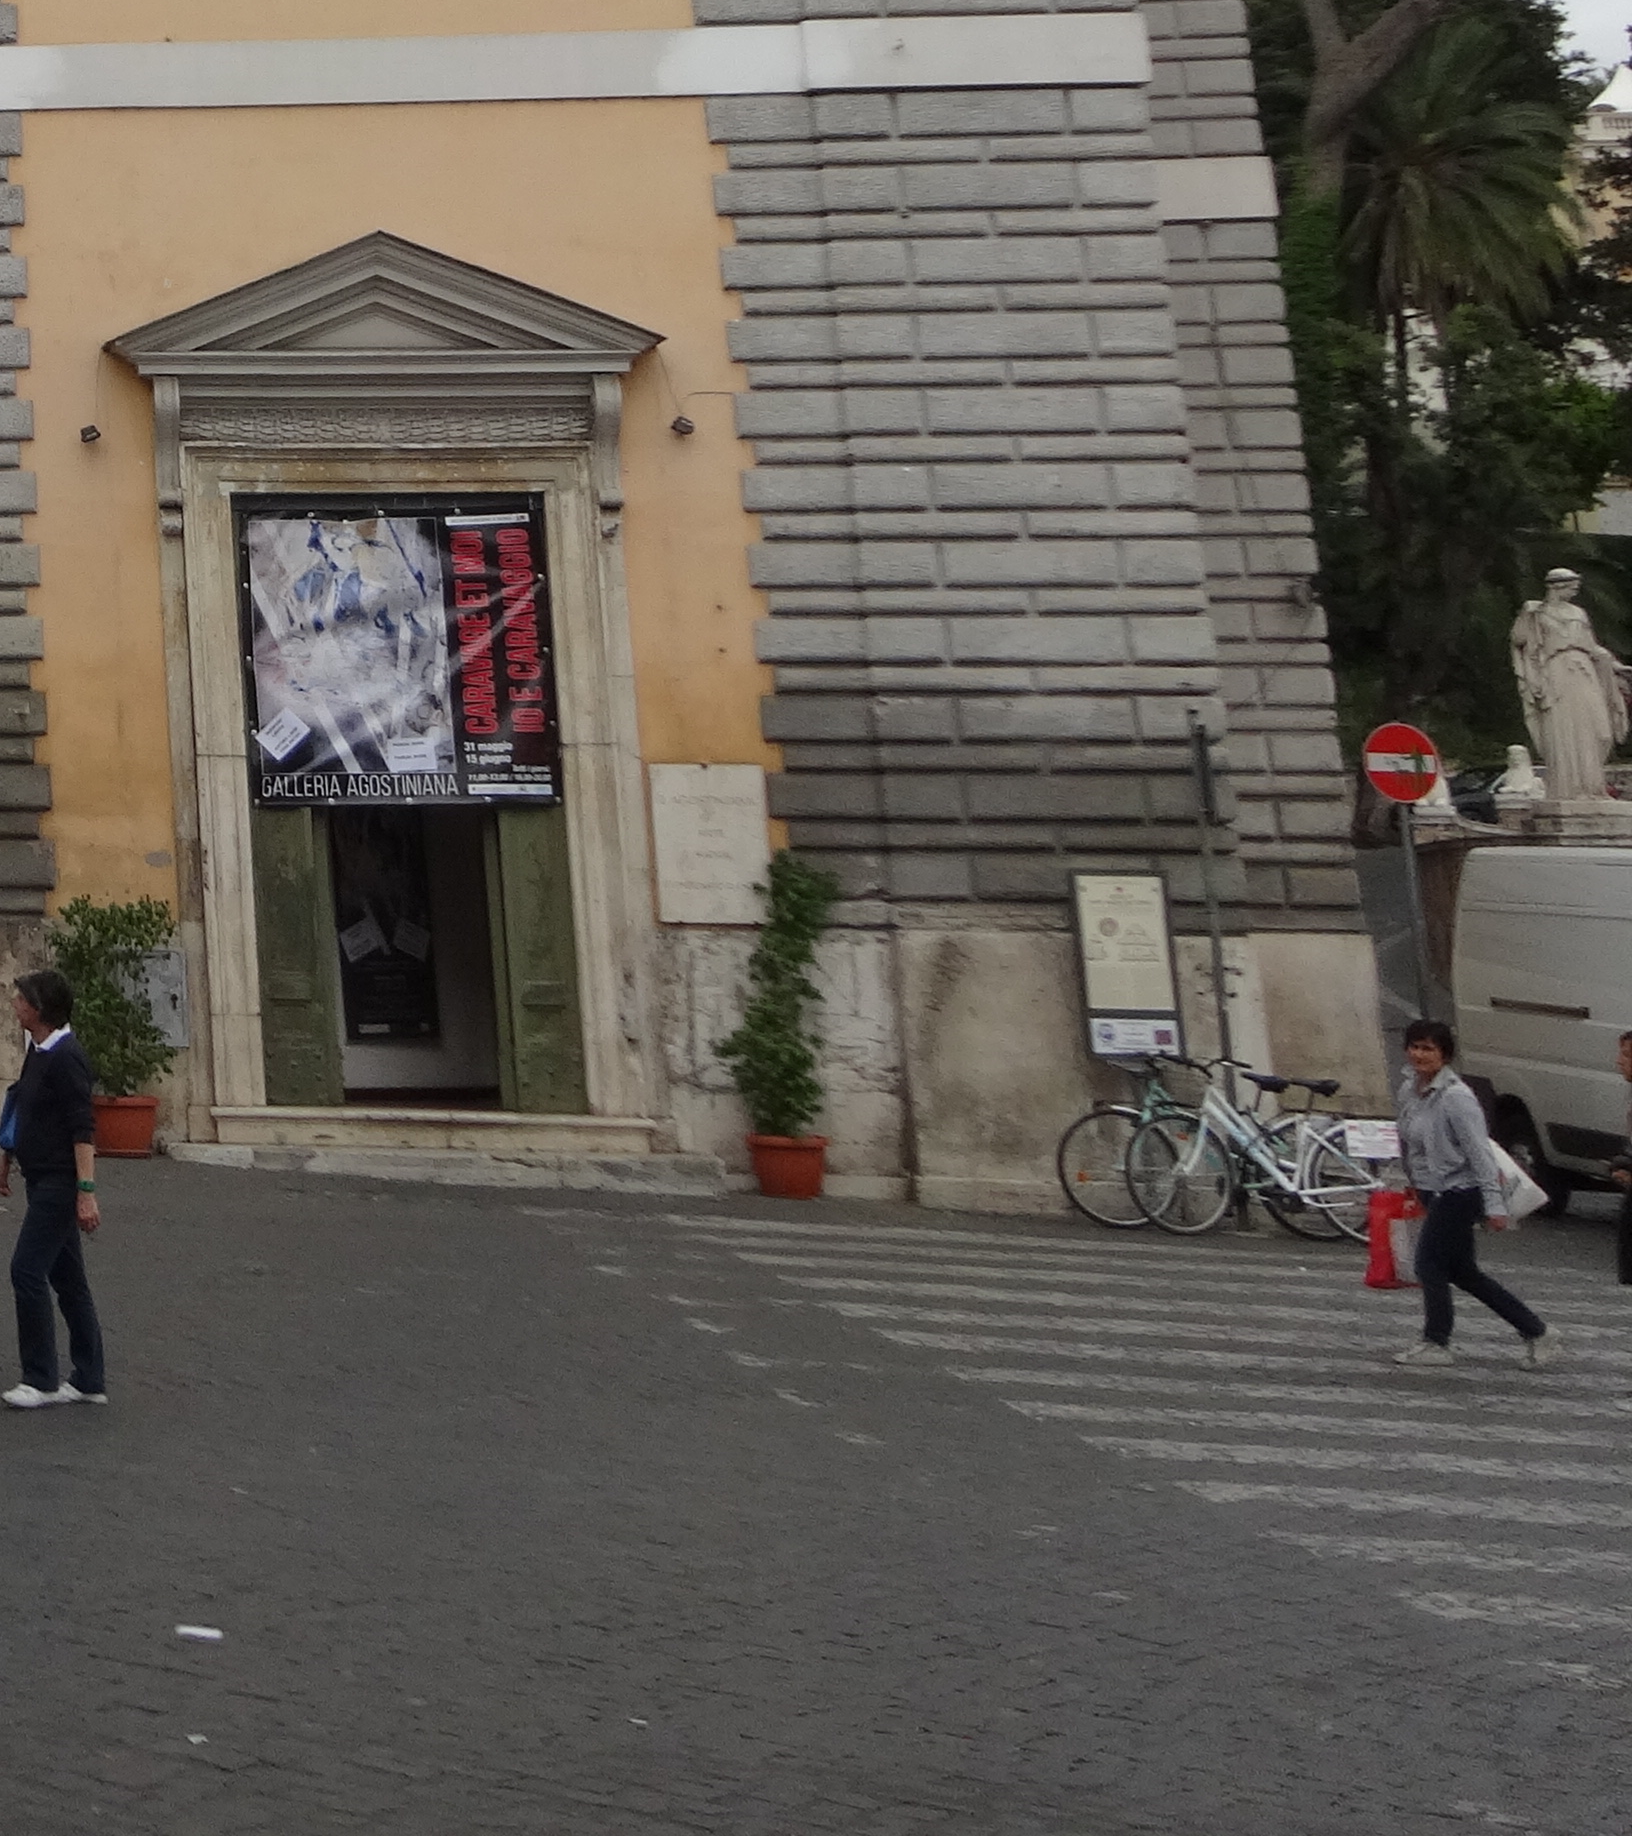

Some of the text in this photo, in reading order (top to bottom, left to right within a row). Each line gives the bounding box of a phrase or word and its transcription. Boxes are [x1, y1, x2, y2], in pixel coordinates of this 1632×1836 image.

[450, 530, 498, 735] CARAVAGE ET MOI
[495, 528, 546, 734] IO E CARAVAGGIO
[262, 774, 460, 798] GALLERIA AGOSTINIANA
